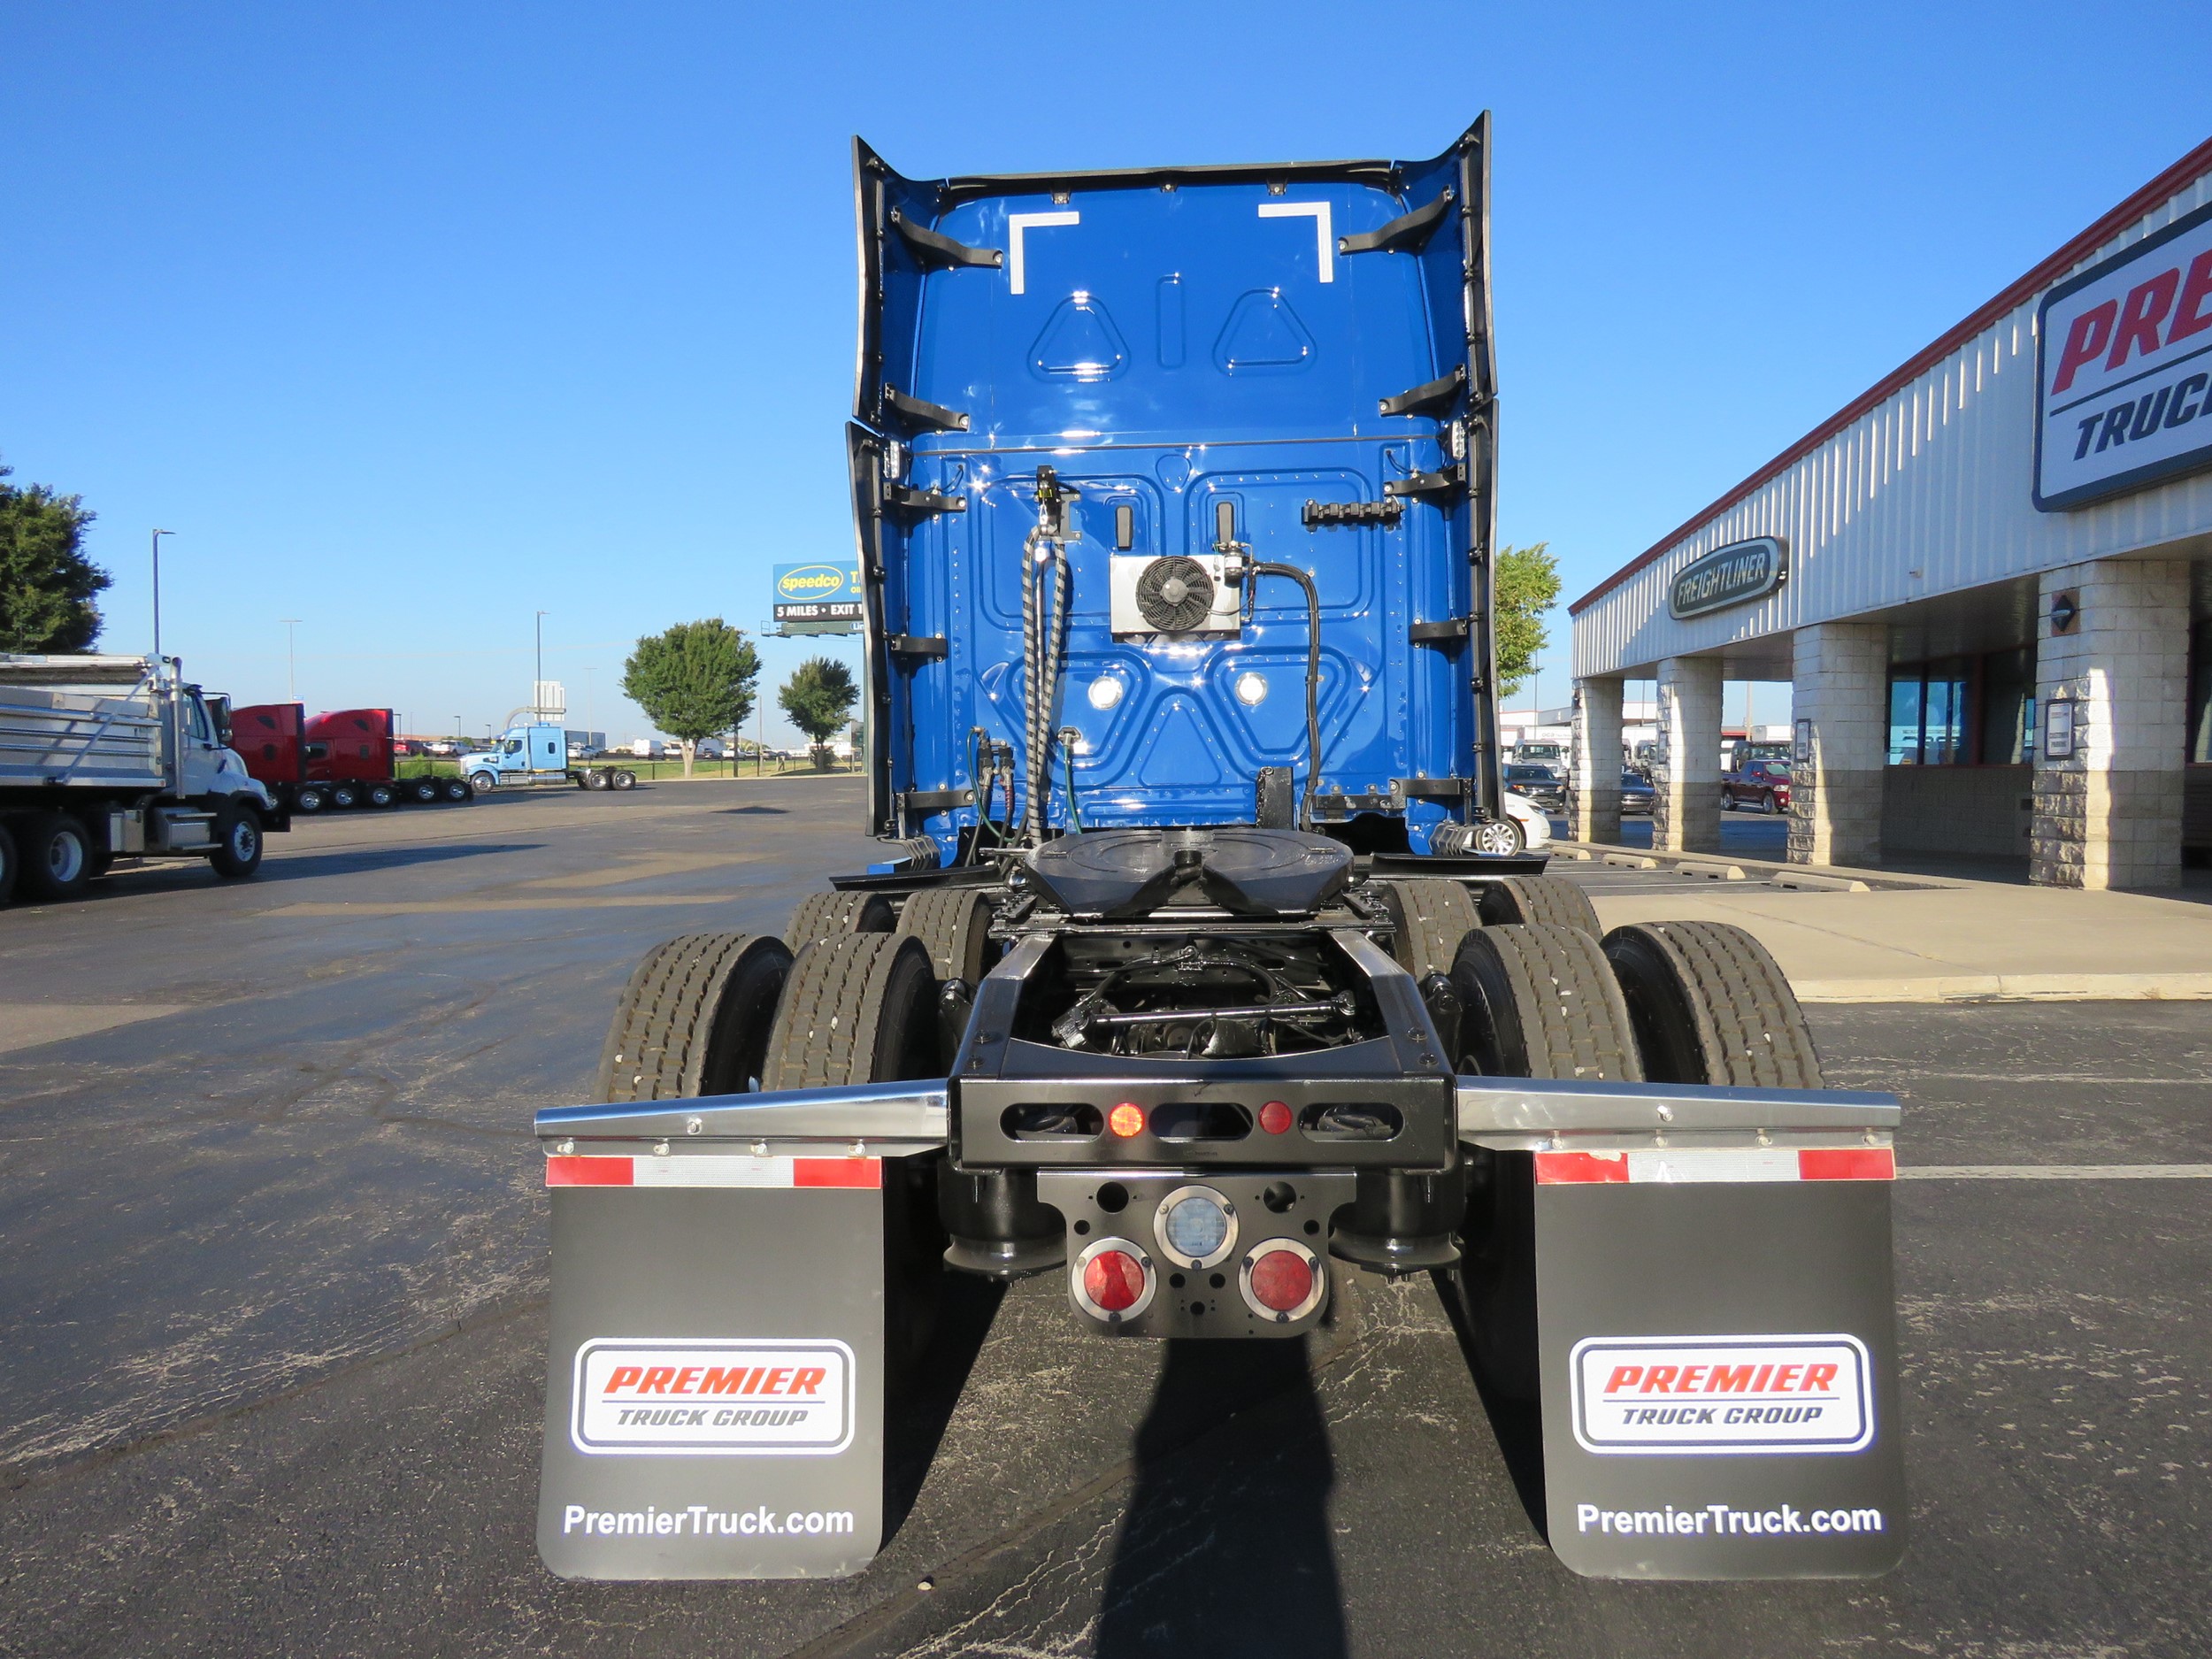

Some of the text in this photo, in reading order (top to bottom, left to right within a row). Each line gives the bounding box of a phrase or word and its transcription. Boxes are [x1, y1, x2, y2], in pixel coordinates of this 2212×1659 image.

[782, 573, 840, 591] speedco
[1677, 552, 1765, 607] FREIGHTLINER
[777, 606, 784, 617] 5
[787, 604, 818, 617] MILES
[830, 604, 856, 615] EXIT
[603, 1366, 826, 1394] PREMIER
[1603, 1363, 1839, 1394] PREMIER
[617, 1409, 809, 1426] TRUCK GROUP
[1622, 1407, 1824, 1425] TRUCK GROUP
[564, 1505, 854, 1534] PremierTruck.com
[1577, 1504, 1883, 1533] PremierTruck.com
